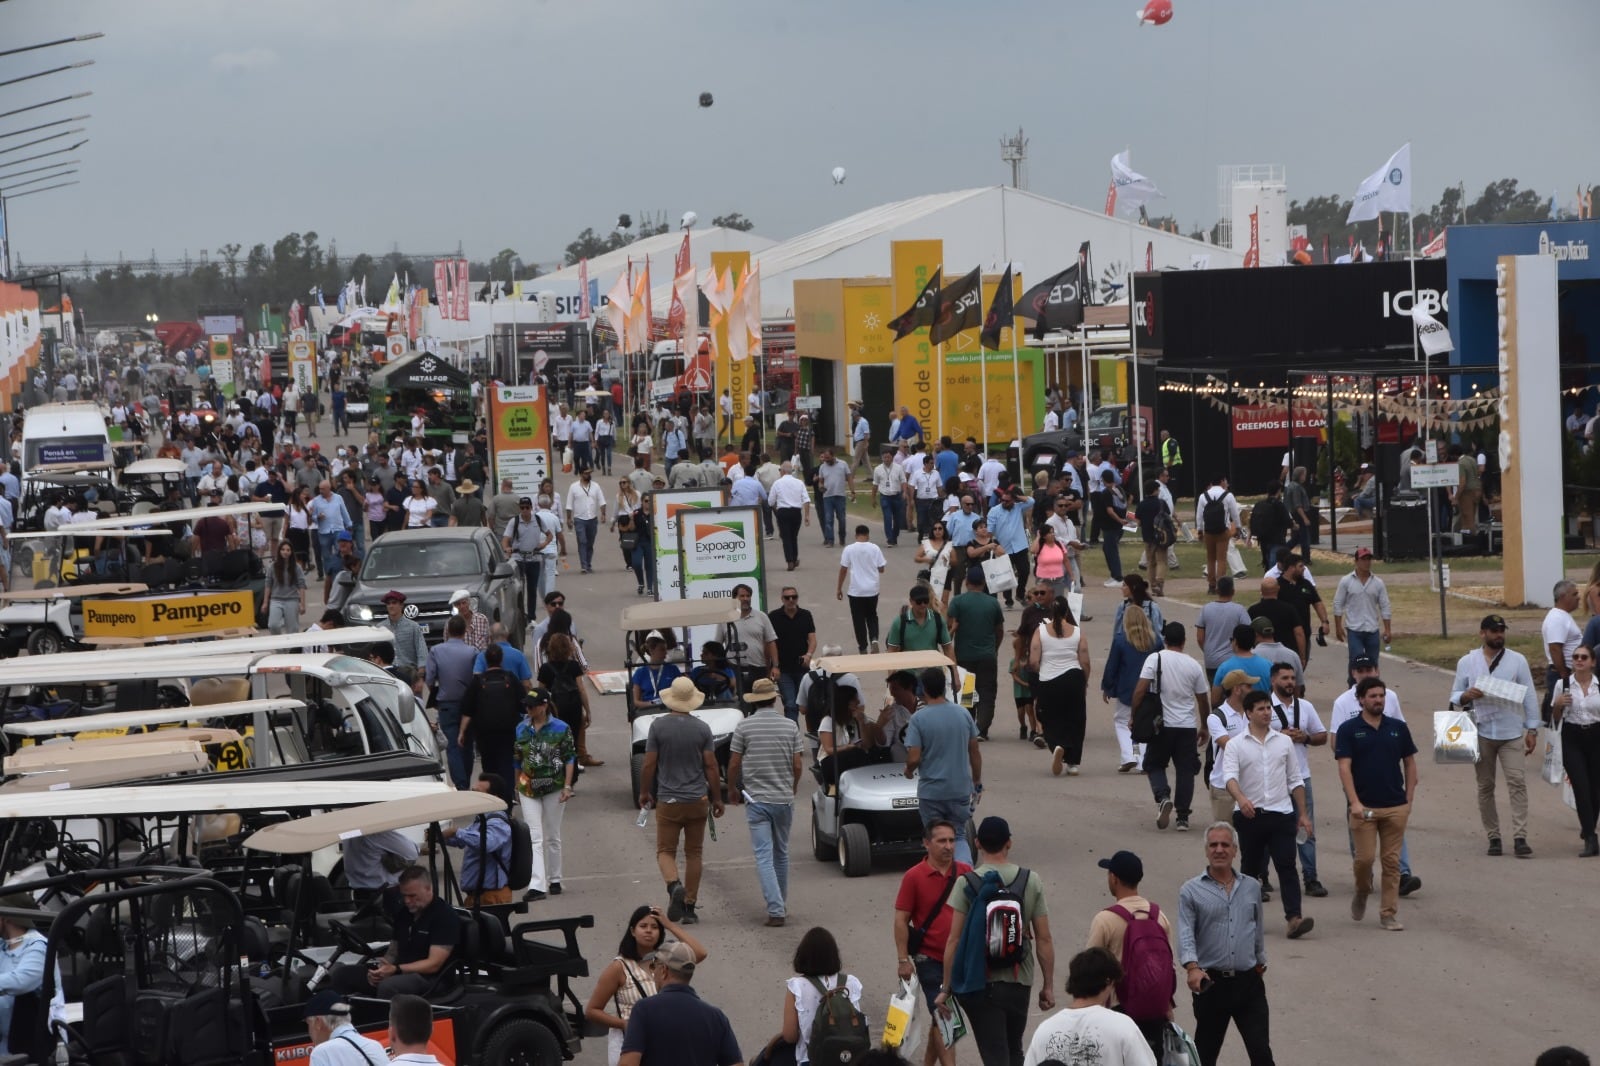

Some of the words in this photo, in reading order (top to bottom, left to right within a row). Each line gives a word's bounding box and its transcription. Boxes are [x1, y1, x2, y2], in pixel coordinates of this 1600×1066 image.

[915, 341, 930, 365] La
[913, 370, 930, 393] de
[1236, 421, 1280, 431] CREEMOS
[696, 541, 746, 553] Expoagro
[726, 553, 747, 563] agro
[87, 609, 136, 626] Pampero
[152, 601, 242, 622] Pampero
[1008, 914, 1016, 943] Wilson
